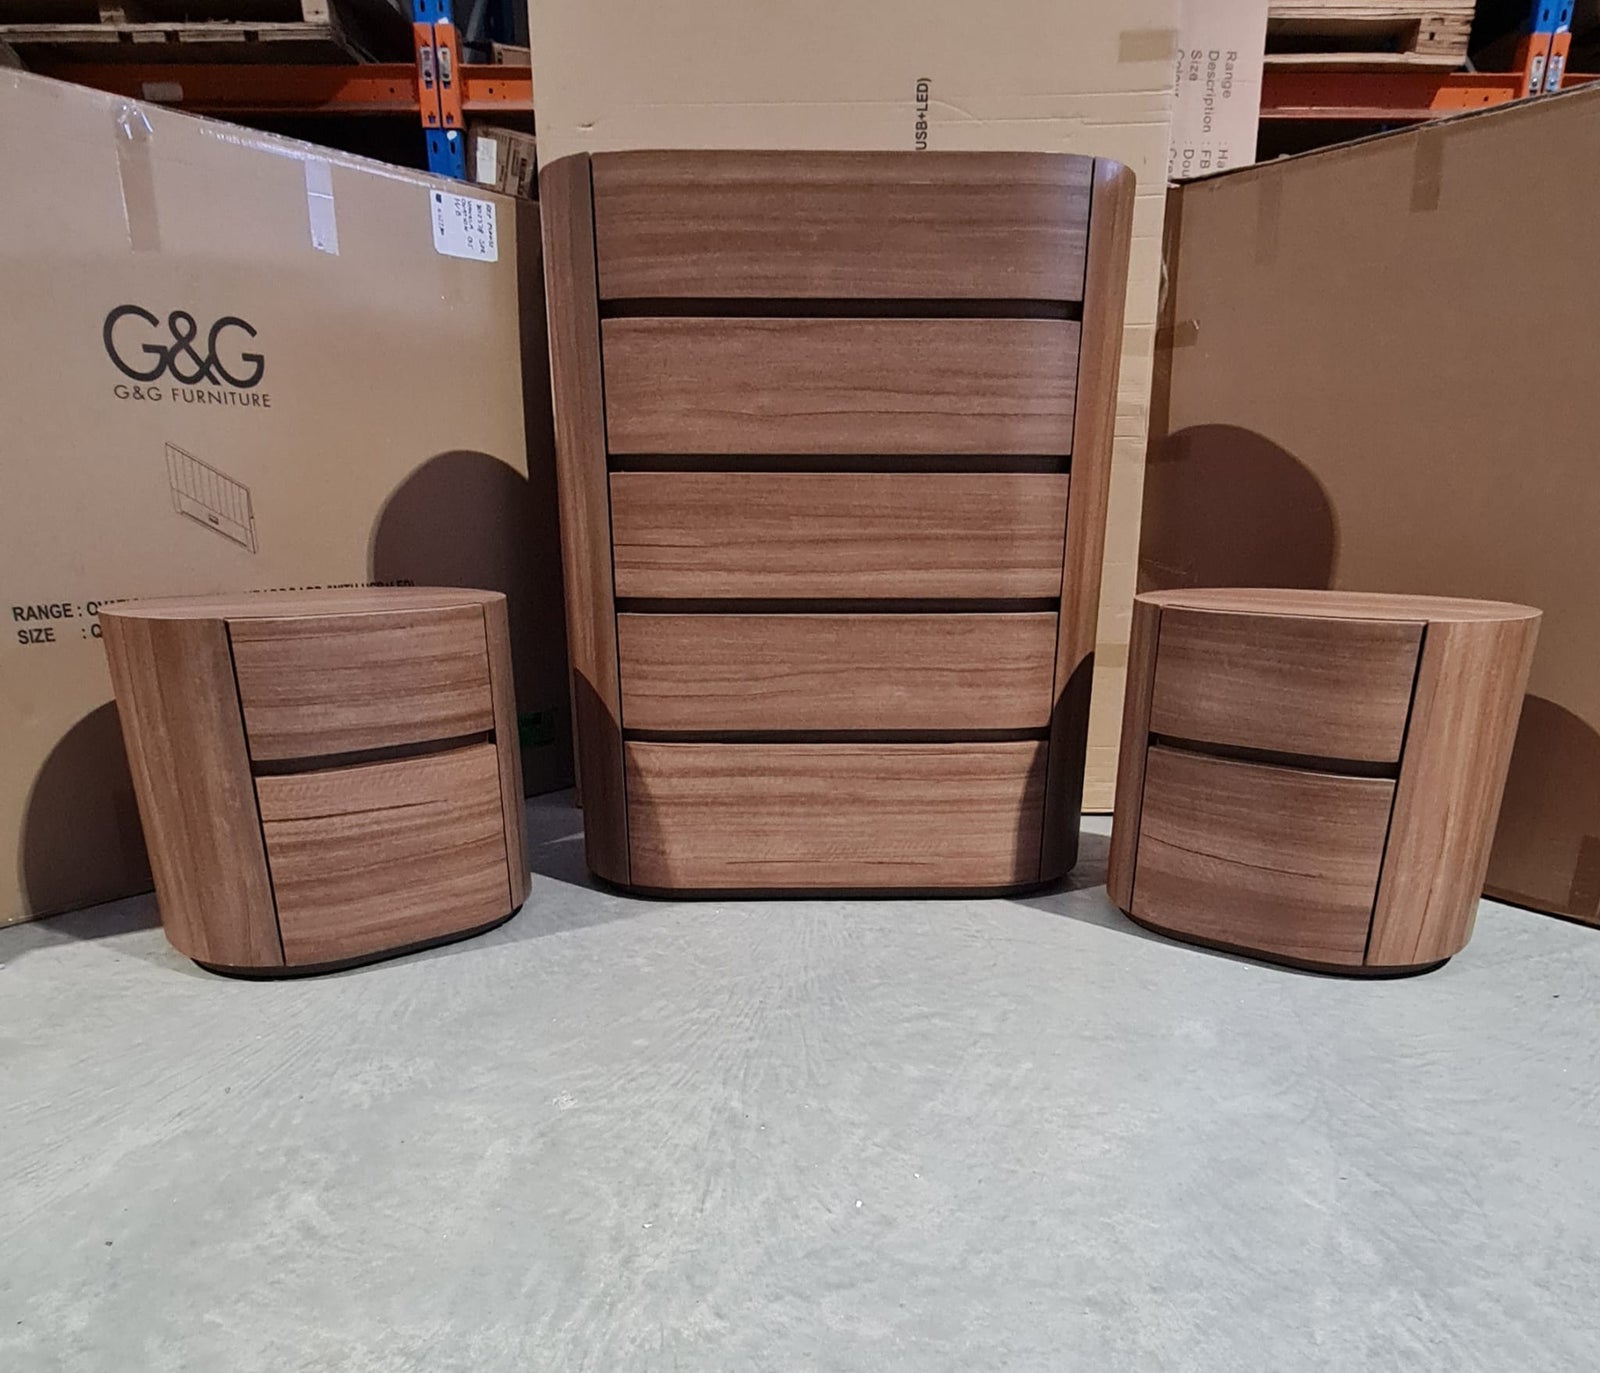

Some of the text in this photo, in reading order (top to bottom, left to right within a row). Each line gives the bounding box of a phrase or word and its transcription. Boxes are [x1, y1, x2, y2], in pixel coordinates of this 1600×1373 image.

[1188, 49, 1203, 82] Size
[1222, 50, 1238, 99] Range
[1202, 50, 1220, 133] Description
[914, 77, 933, 151] USB+LED)
[1199, 149, 1212, 169] FB
[102, 304, 265, 389] G&G
[113, 384, 272, 408] G&G FURNITURE
[17, 627, 57, 645] SIZE
